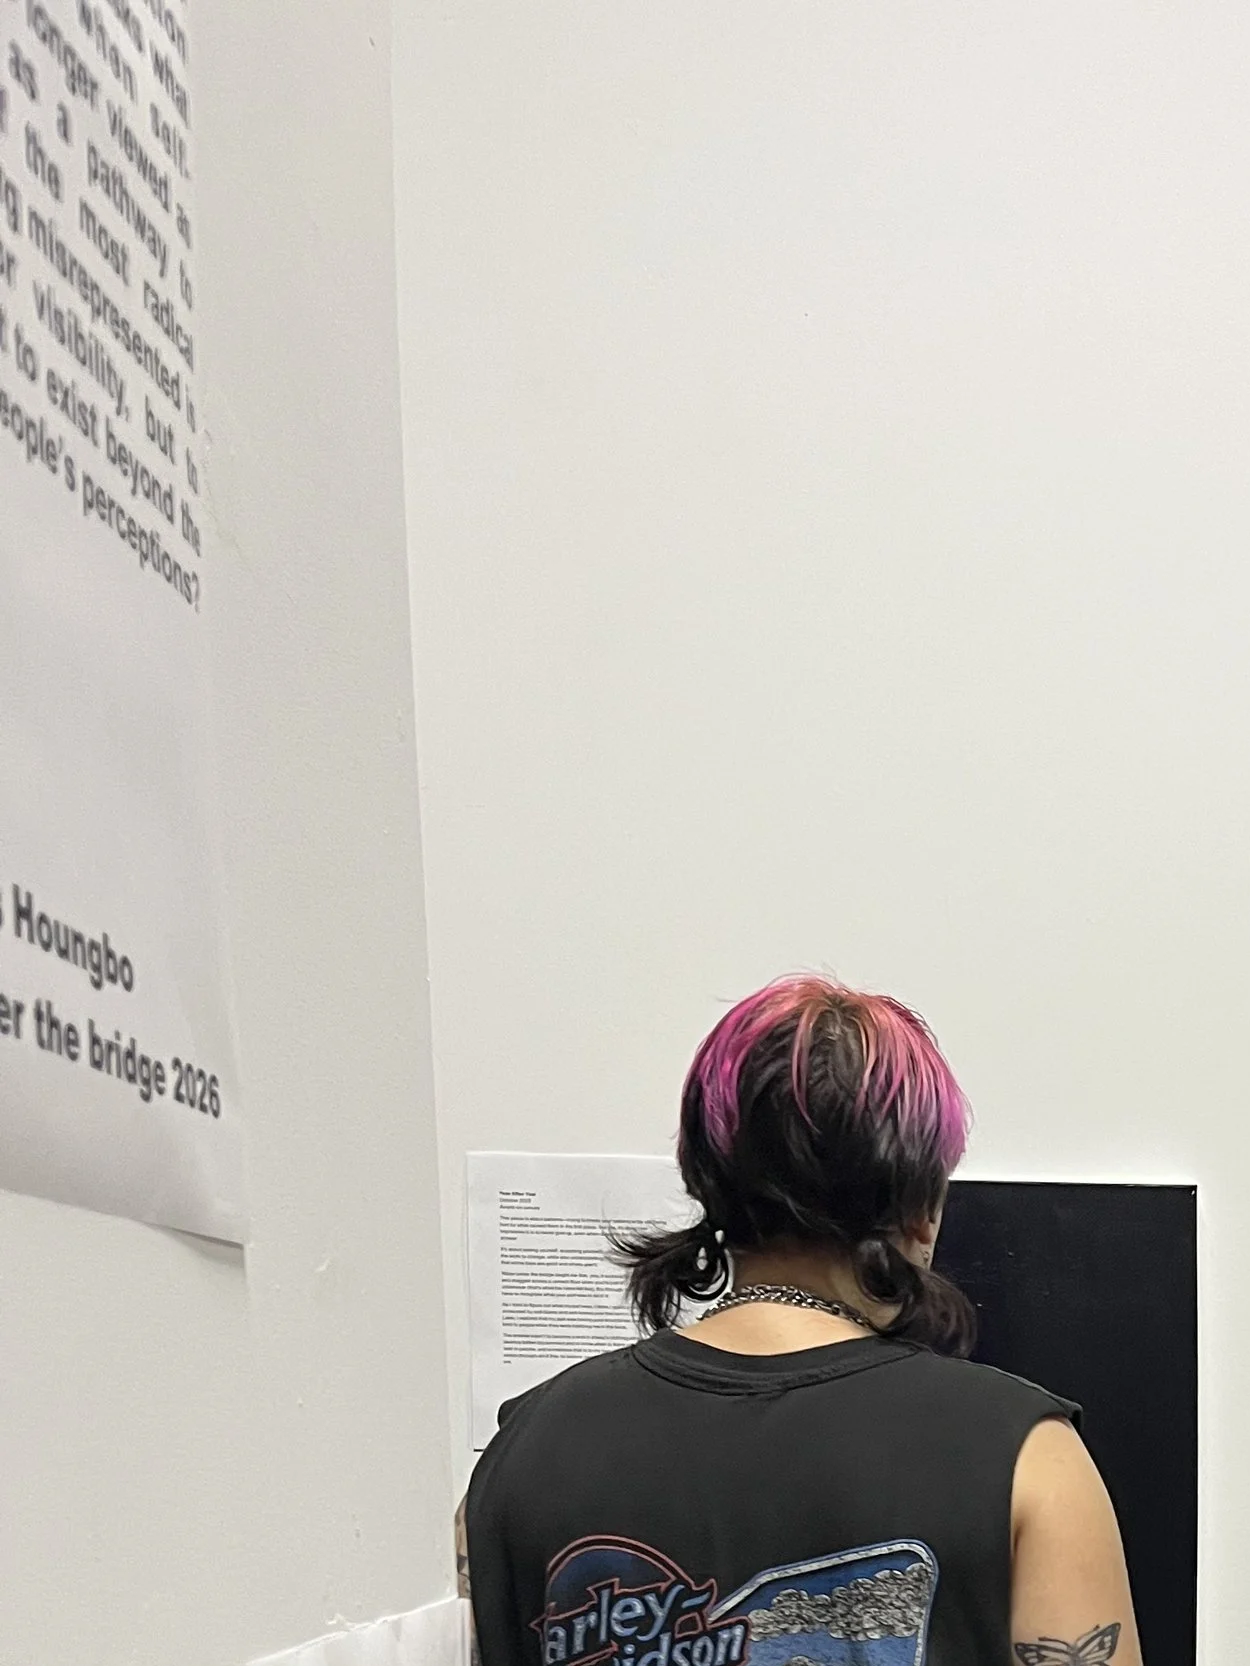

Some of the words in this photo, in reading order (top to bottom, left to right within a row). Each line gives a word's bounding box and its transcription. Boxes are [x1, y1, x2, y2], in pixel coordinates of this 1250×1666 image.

[57, 101, 69, 144] a
[87, 139, 167, 278] pathway
[180, 260, 192, 309] to
[107, 99, 170, 212] viewed
[25, 121, 61, 201] the
[80, 198, 130, 285] most
[144, 280, 194, 373] radical
[28, 206, 181, 411] misrepresented
[186, 383, 195, 433] is
[14, 323, 37, 381] to
[46, 368, 99, 447] exist
[106, 416, 174, 524] beyond
[181, 498, 200, 557] the
[33, 280, 130, 422] visibility,
[145, 394, 175, 465] but
[186, 447, 198, 496] to
[82, 470, 200, 613] perceptions?
[12, 883, 134, 992] Houngbo
[33, 998, 80, 1061] the
[88, 1017, 166, 1103] bridge
[171, 1057, 221, 1118] 2026
[546, 1584, 712, 1665] arley-
